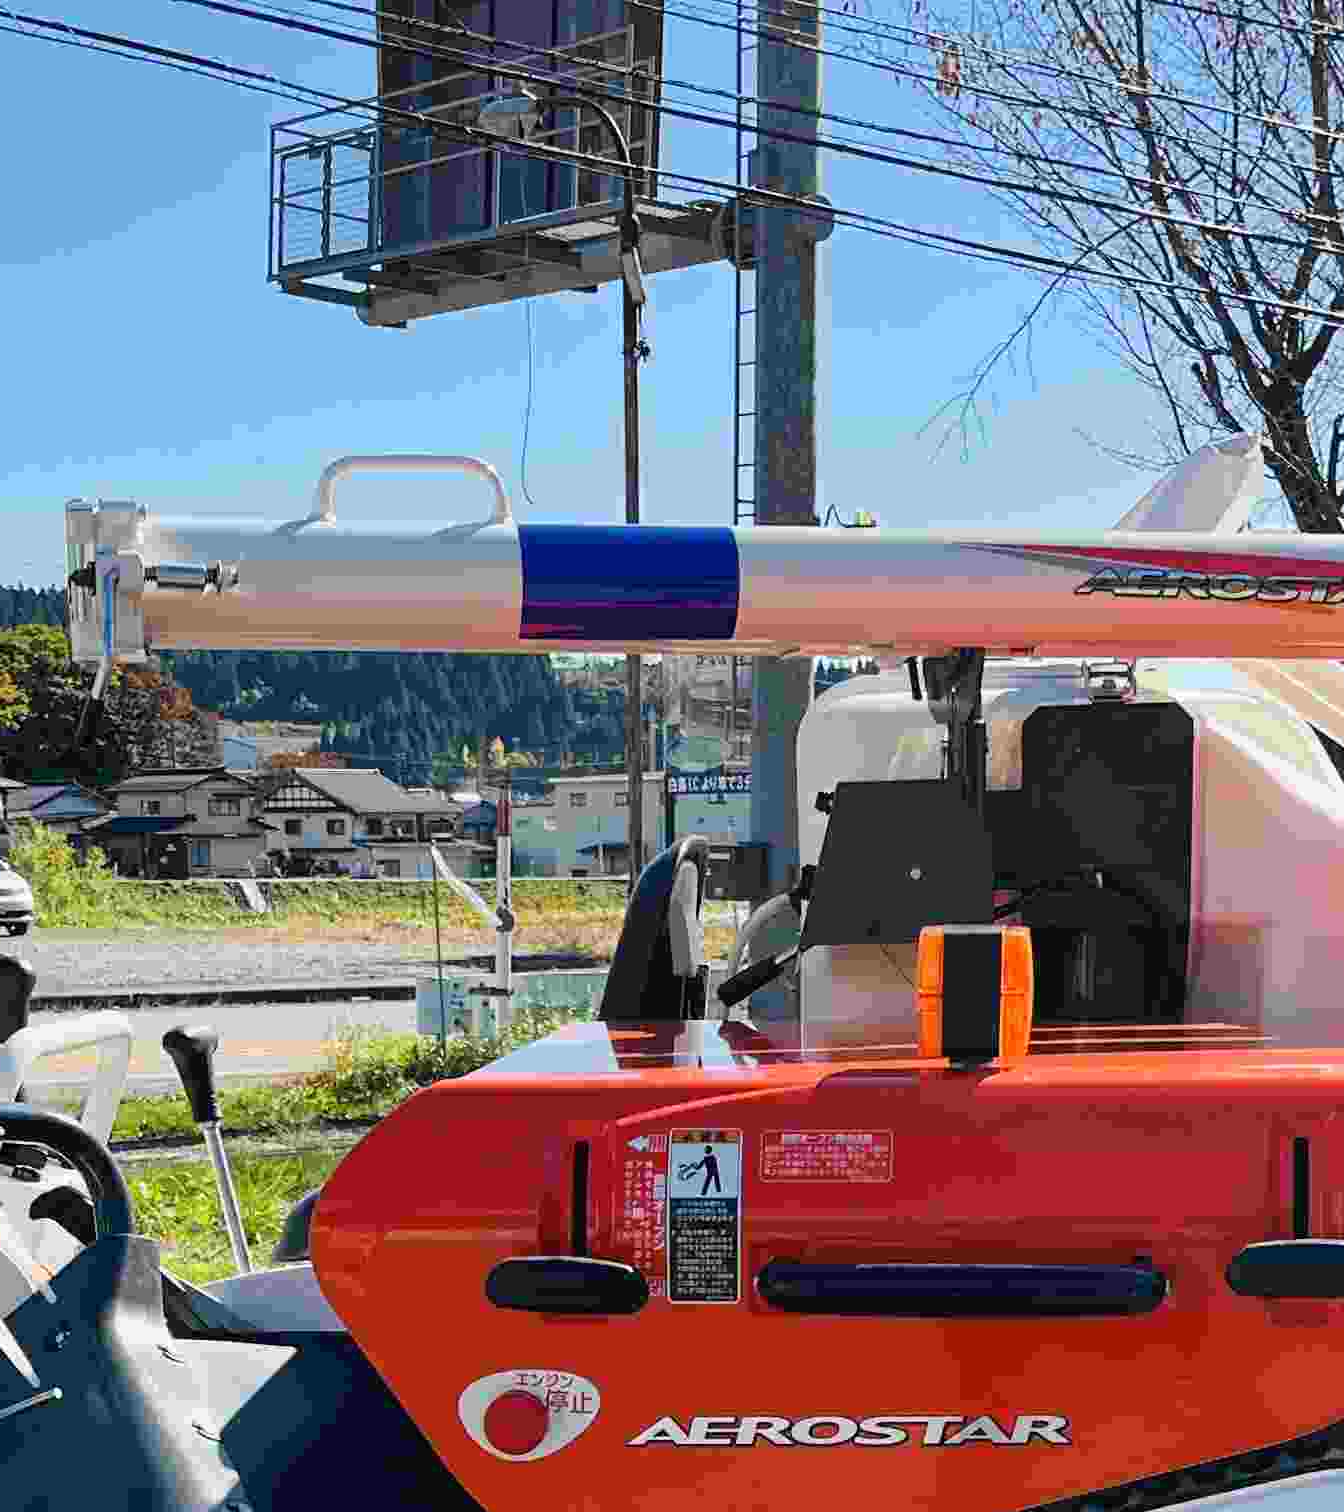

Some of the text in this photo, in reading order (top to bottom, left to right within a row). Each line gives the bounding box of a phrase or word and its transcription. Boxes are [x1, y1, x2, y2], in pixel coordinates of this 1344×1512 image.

[513, 1373, 575, 1388] エンジン
[544, 1389, 594, 1415] 停止
[624, 1415, 1073, 1449] AEROSTAR
